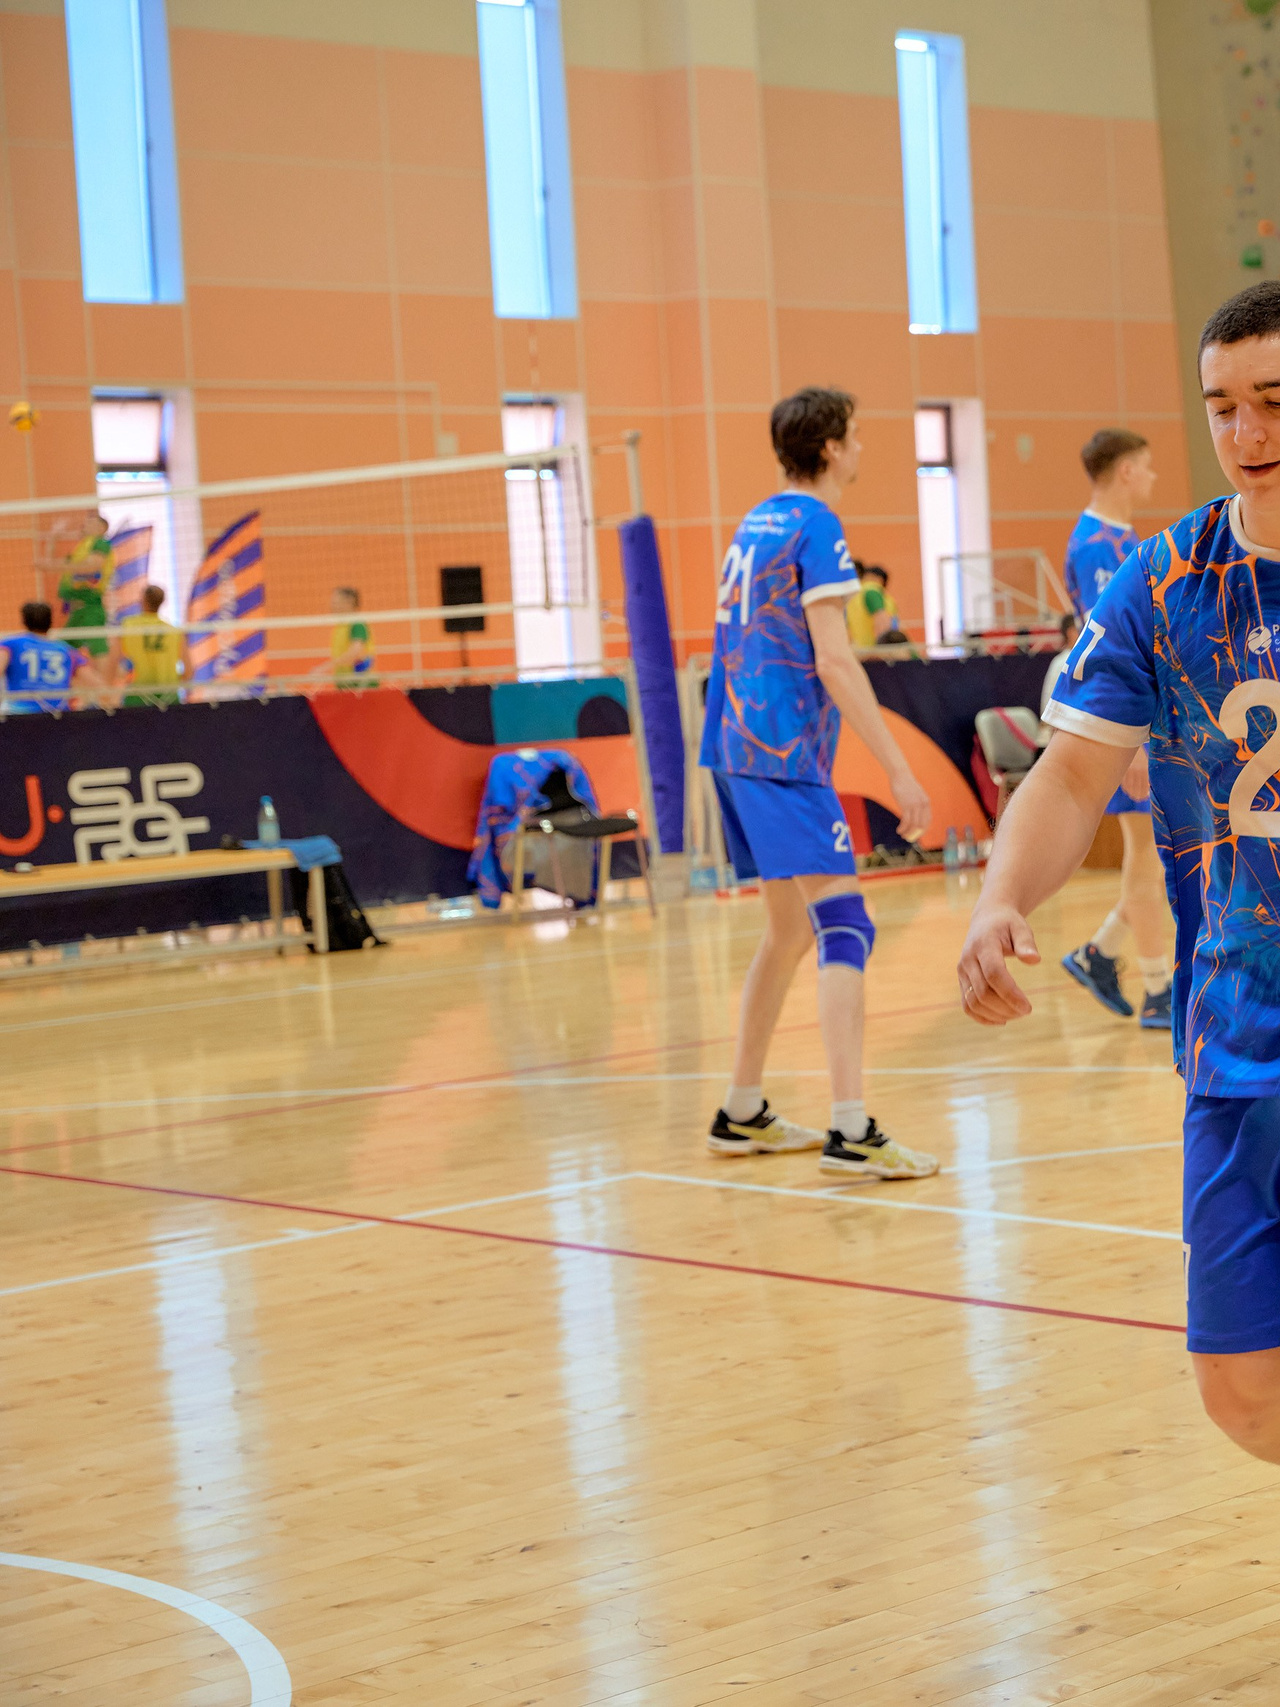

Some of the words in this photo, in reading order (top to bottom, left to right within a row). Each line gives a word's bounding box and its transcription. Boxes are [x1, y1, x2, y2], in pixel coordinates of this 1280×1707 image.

[715, 543, 756, 626] 21
[20, 649, 65, 684] 13
[1060, 618, 1106, 681] 7
[831, 820, 851, 853] 2
